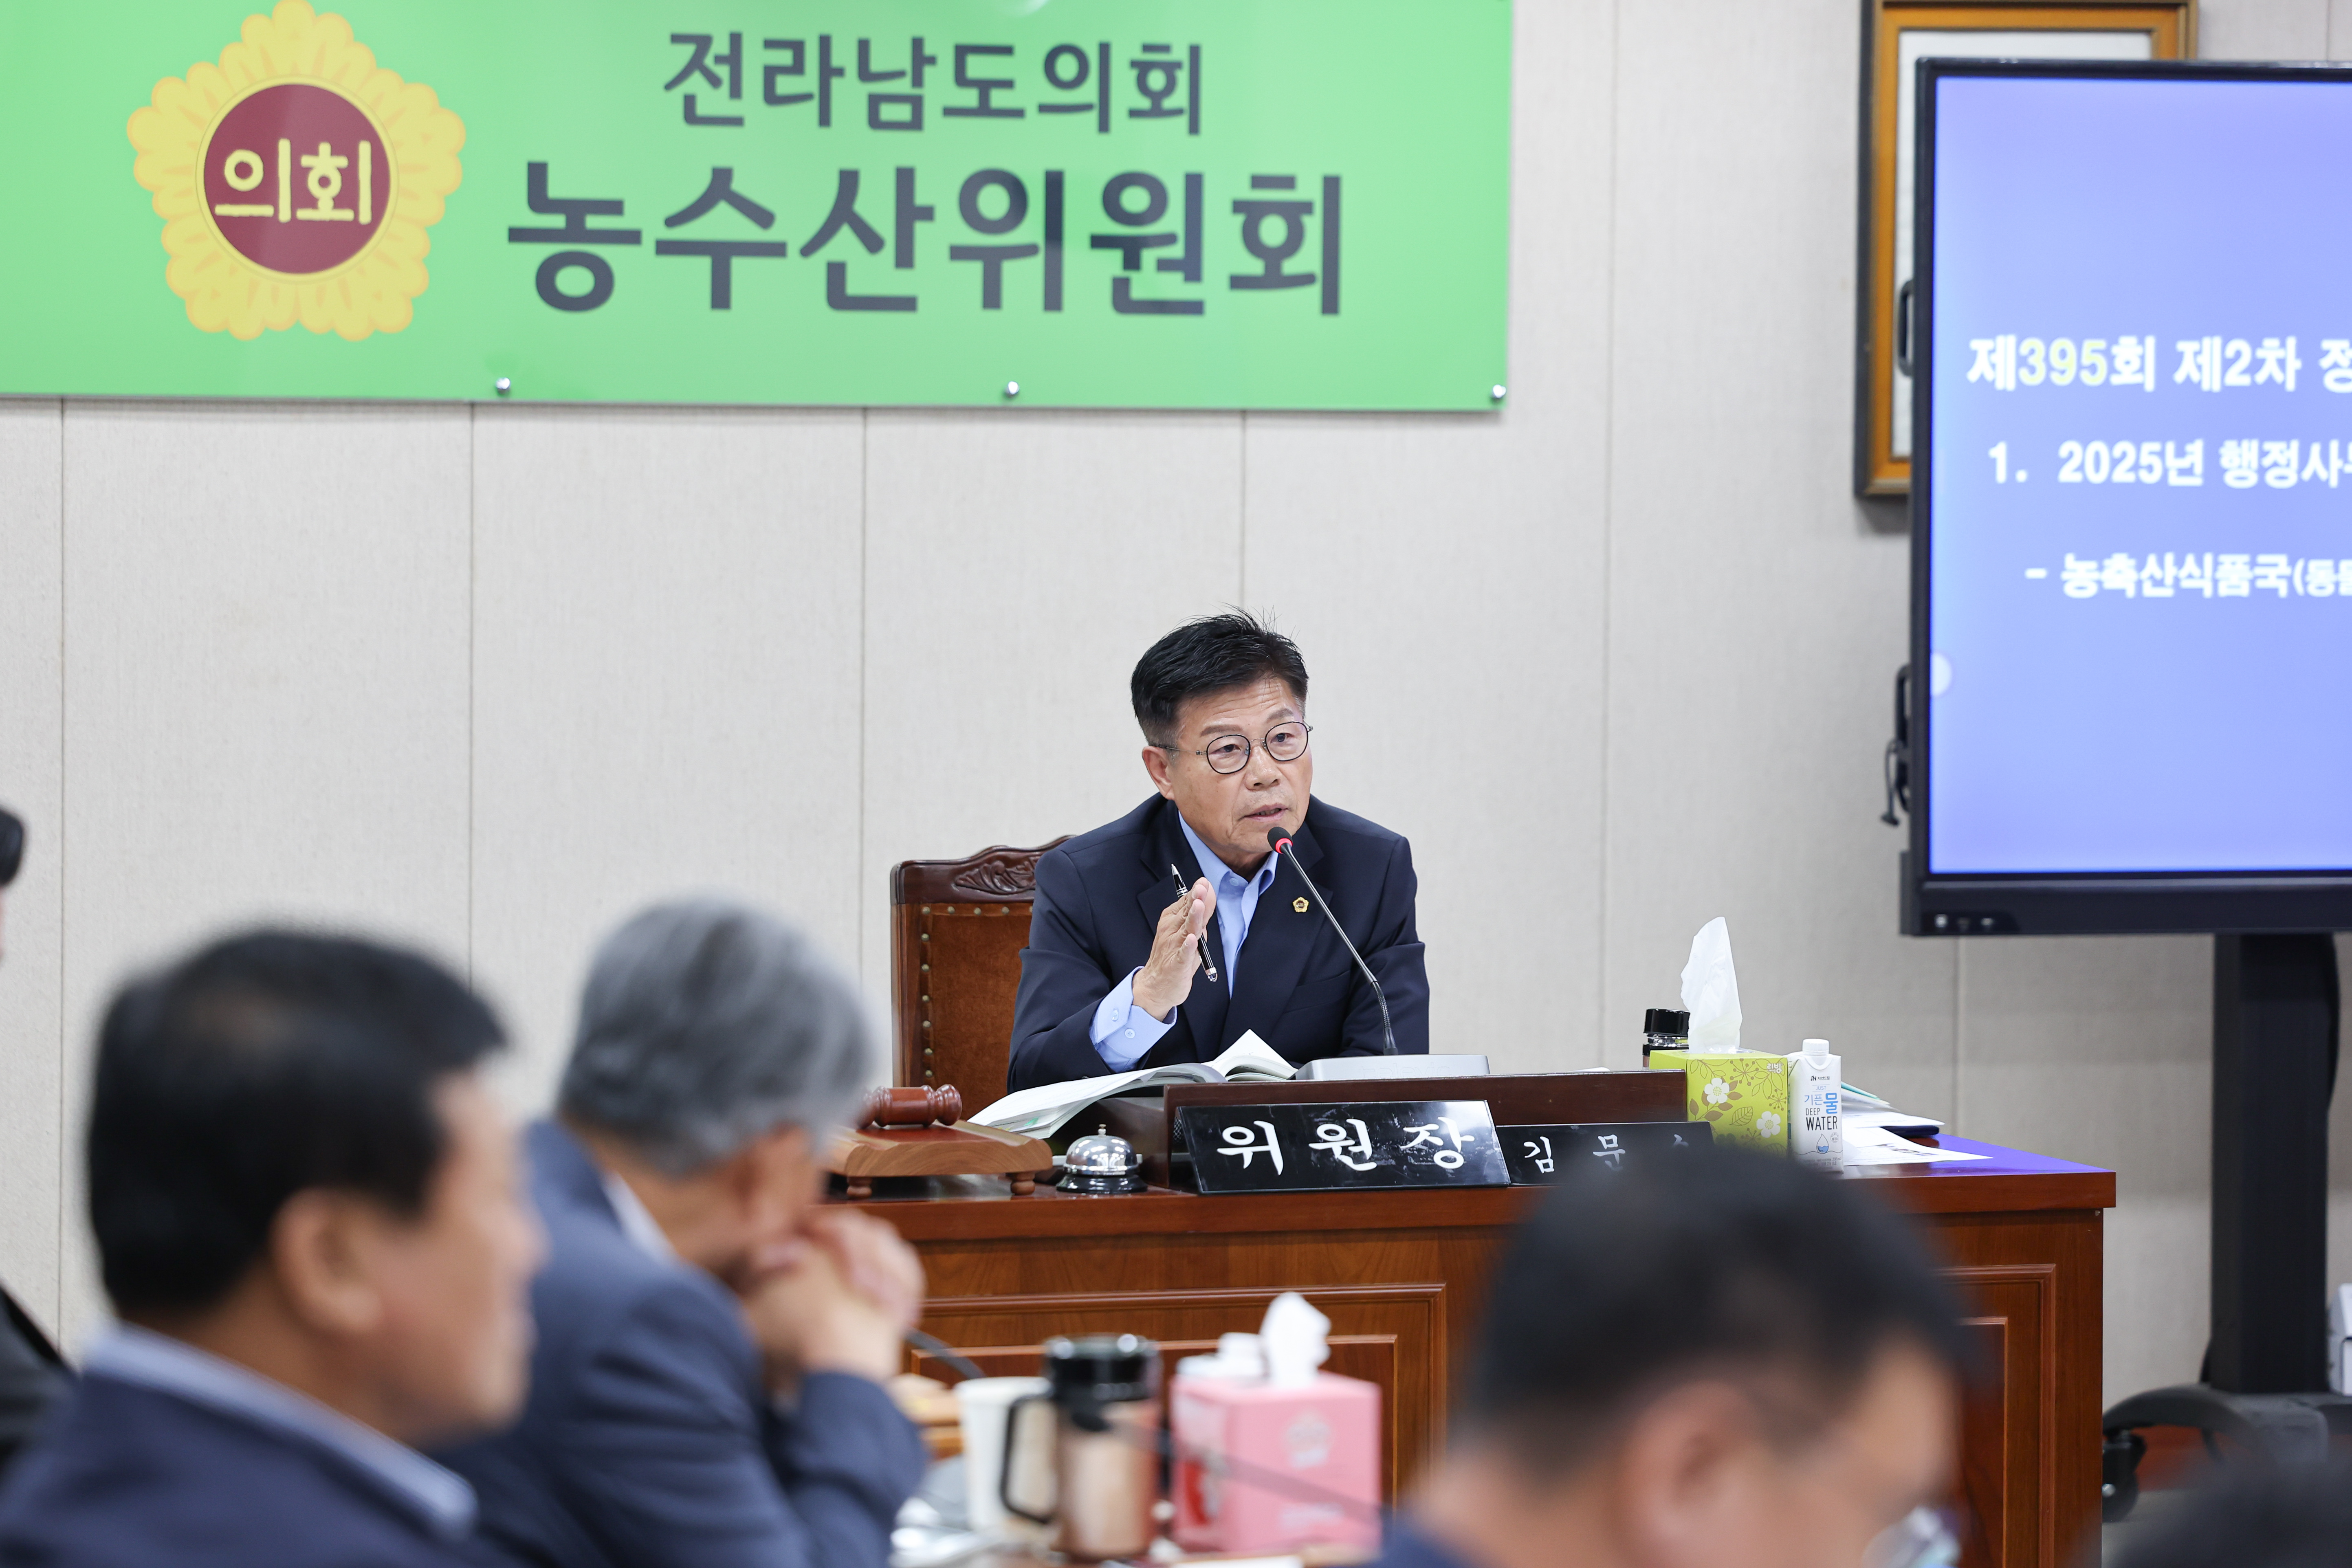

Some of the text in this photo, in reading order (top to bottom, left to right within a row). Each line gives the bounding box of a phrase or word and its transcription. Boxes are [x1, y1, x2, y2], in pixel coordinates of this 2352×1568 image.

[664, 32, 1200, 134] 전라남도의회
[215, 138, 372, 225] 의회
[508, 161, 1342, 315] 농수산위원회
[1967, 334, 2155, 392] 제395회
[2174, 336, 2302, 392] 제2차
[1987, 439, 2352, 489] 1. 2025년 행정사
[1767, 1062, 1783, 1073] 리빙
[1804, 1094, 1823, 1105] 기픈
[1823, 1093, 1838, 1114] 물
[1806, 1116, 1837, 1130] WATER
